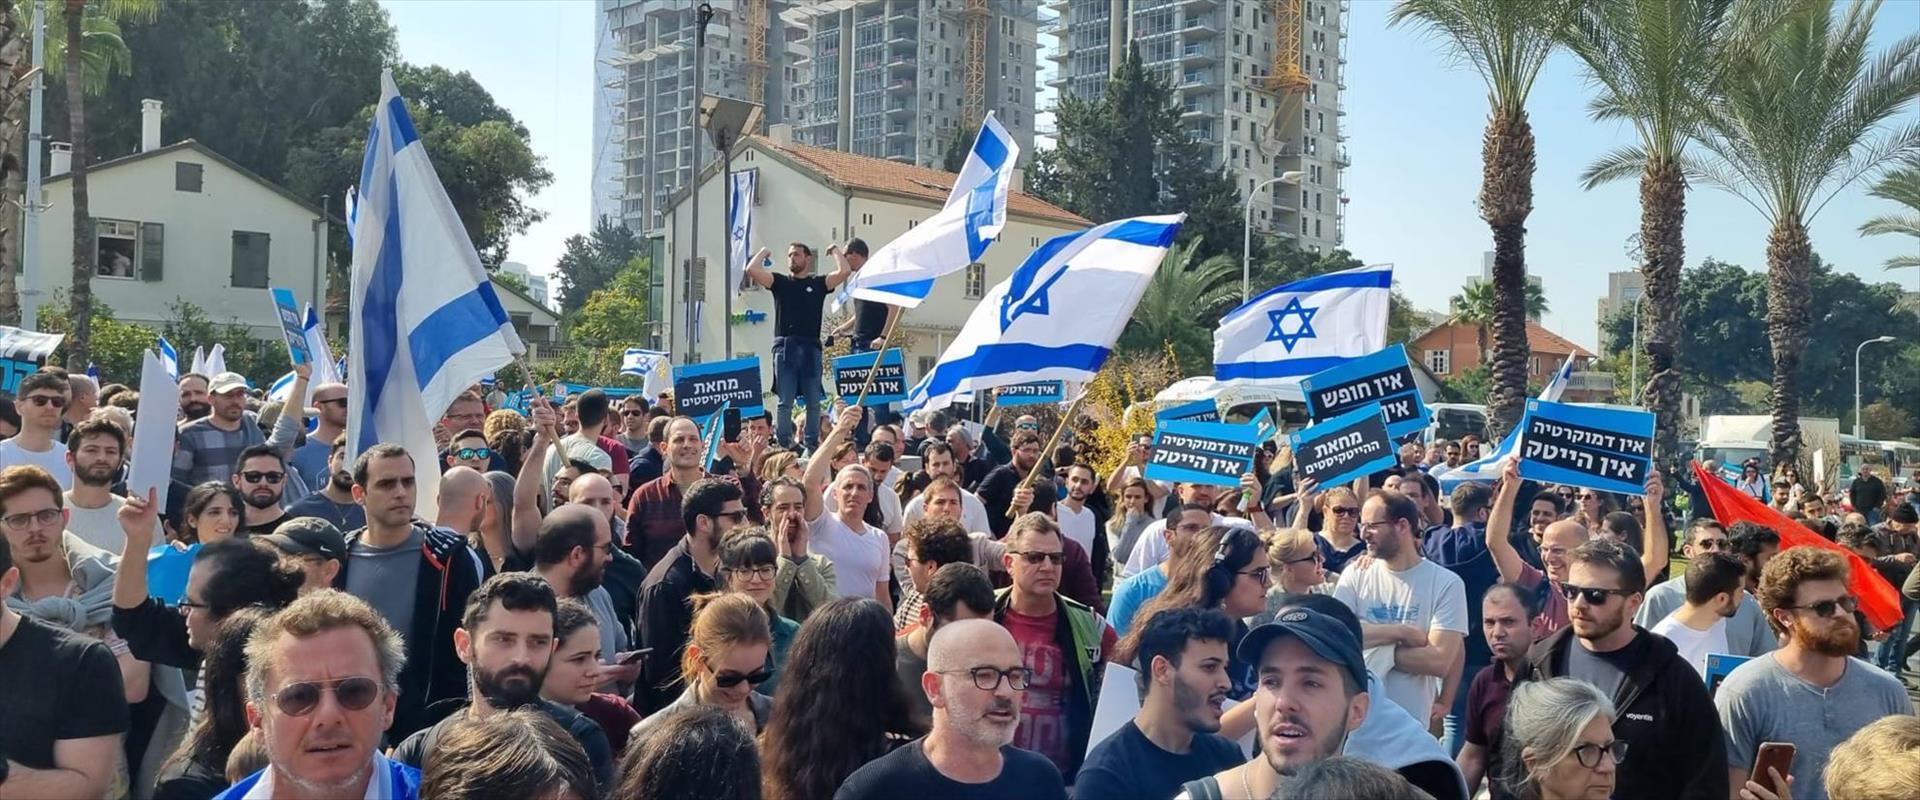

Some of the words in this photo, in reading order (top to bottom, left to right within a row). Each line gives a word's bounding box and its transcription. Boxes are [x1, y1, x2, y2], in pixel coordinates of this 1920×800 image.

[885, 366, 900, 376] אין
[693, 378, 738, 395] מחאת
[879, 381, 899, 395] אין
[1037, 385, 1055, 396] אין
[1373, 372, 1404, 396] אין
[681, 390, 753, 407] ההייטקיסטים
[1321, 381, 1372, 409] חופש
[1381, 400, 1410, 423] אין
[1162, 435, 1226, 452] דמוקרטיה
[1533, 421, 1616, 448] דמוקרטיה
[1228, 443, 1249, 455] אין
[1314, 431, 1363, 459] מחאת
[1619, 438, 1646, 454] אין
[1153, 449, 1208, 470] הייטק
[1305, 440, 1380, 475] ההייטקיסטים
[1525, 440, 1594, 470] הייטק
[1211, 458, 1240, 475] אין
[1600, 456, 1636, 479] אין
